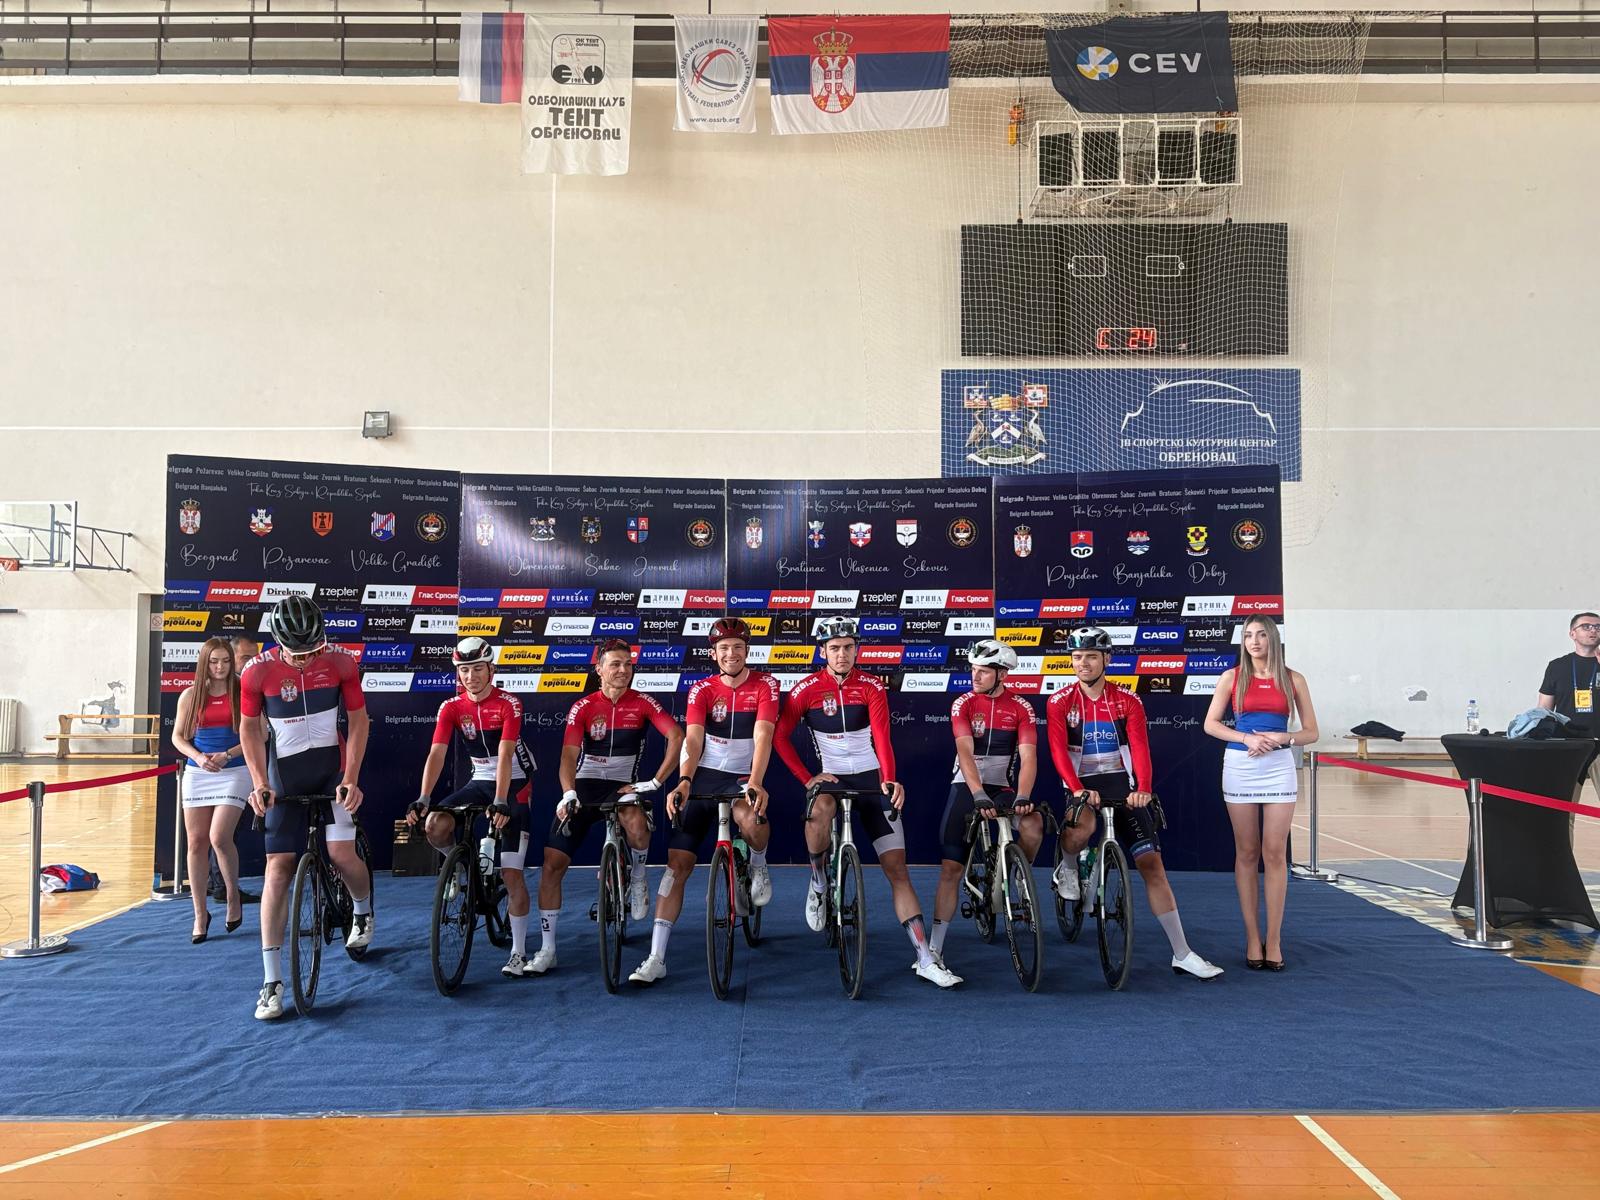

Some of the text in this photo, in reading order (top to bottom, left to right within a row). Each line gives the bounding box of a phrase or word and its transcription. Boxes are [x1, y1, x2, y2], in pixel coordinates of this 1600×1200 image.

[1127, 51, 1202, 74] CEV
[528, 95, 625, 107] ОДБОЈКАШКИ КЛУБ
[700, 98, 735, 108] FEDERATION
[734, 93, 741, 101] OF
[549, 107, 604, 127] ТЕНТ
[689, 116, 740, 124] www.ossrb.org
[531, 126, 621, 140] ОБРЕНОВАЦ
[1178, 262, 1185, 270] G
[1129, 329, 1154, 348] 24
[1133, 438, 1184, 447] СПОРТСКО
[1186, 438, 1237, 447] КУЛТУРНИ
[1239, 439, 1277, 448] ЦЕНТАР
[1159, 452, 1236, 463] ОБРЕНОВАЦ
[443, 480, 459, 488] Doboj
[1258, 486, 1274, 494] Doboj
[180, 544, 239, 571] Beograd
[1188, 562, 1227, 585] Doboj
[211, 588, 258, 597] metago
[326, 588, 358, 597] zepter
[605, 592, 634, 602] zepter
[868, 593, 897, 602] zepter
[503, 595, 544, 603] metago
[1146, 600, 1178, 611] zepter
[372, 618, 406, 627] zepter
[650, 620, 678, 630] zepter
[912, 620, 941, 630] zepter
[1142, 631, 1178, 639] CASIO
[1195, 628, 1226, 637] zepter
[862, 651, 901, 659] metago
[1141, 660, 1184, 668] metago
[791, 676, 819, 699] SRBIJA
[688, 681, 711, 705] SRBIJA
[499, 693, 521, 718] SRBIJA
[951, 691, 975, 716] SRBIJA
[568, 699, 590, 725] SRBIJA
[1012, 695, 1036, 724] SRBIJA
[385, 715, 411, 724] Belgrade
[925, 715, 950, 723] Belgrade
[1084, 729, 1118, 741] epter
